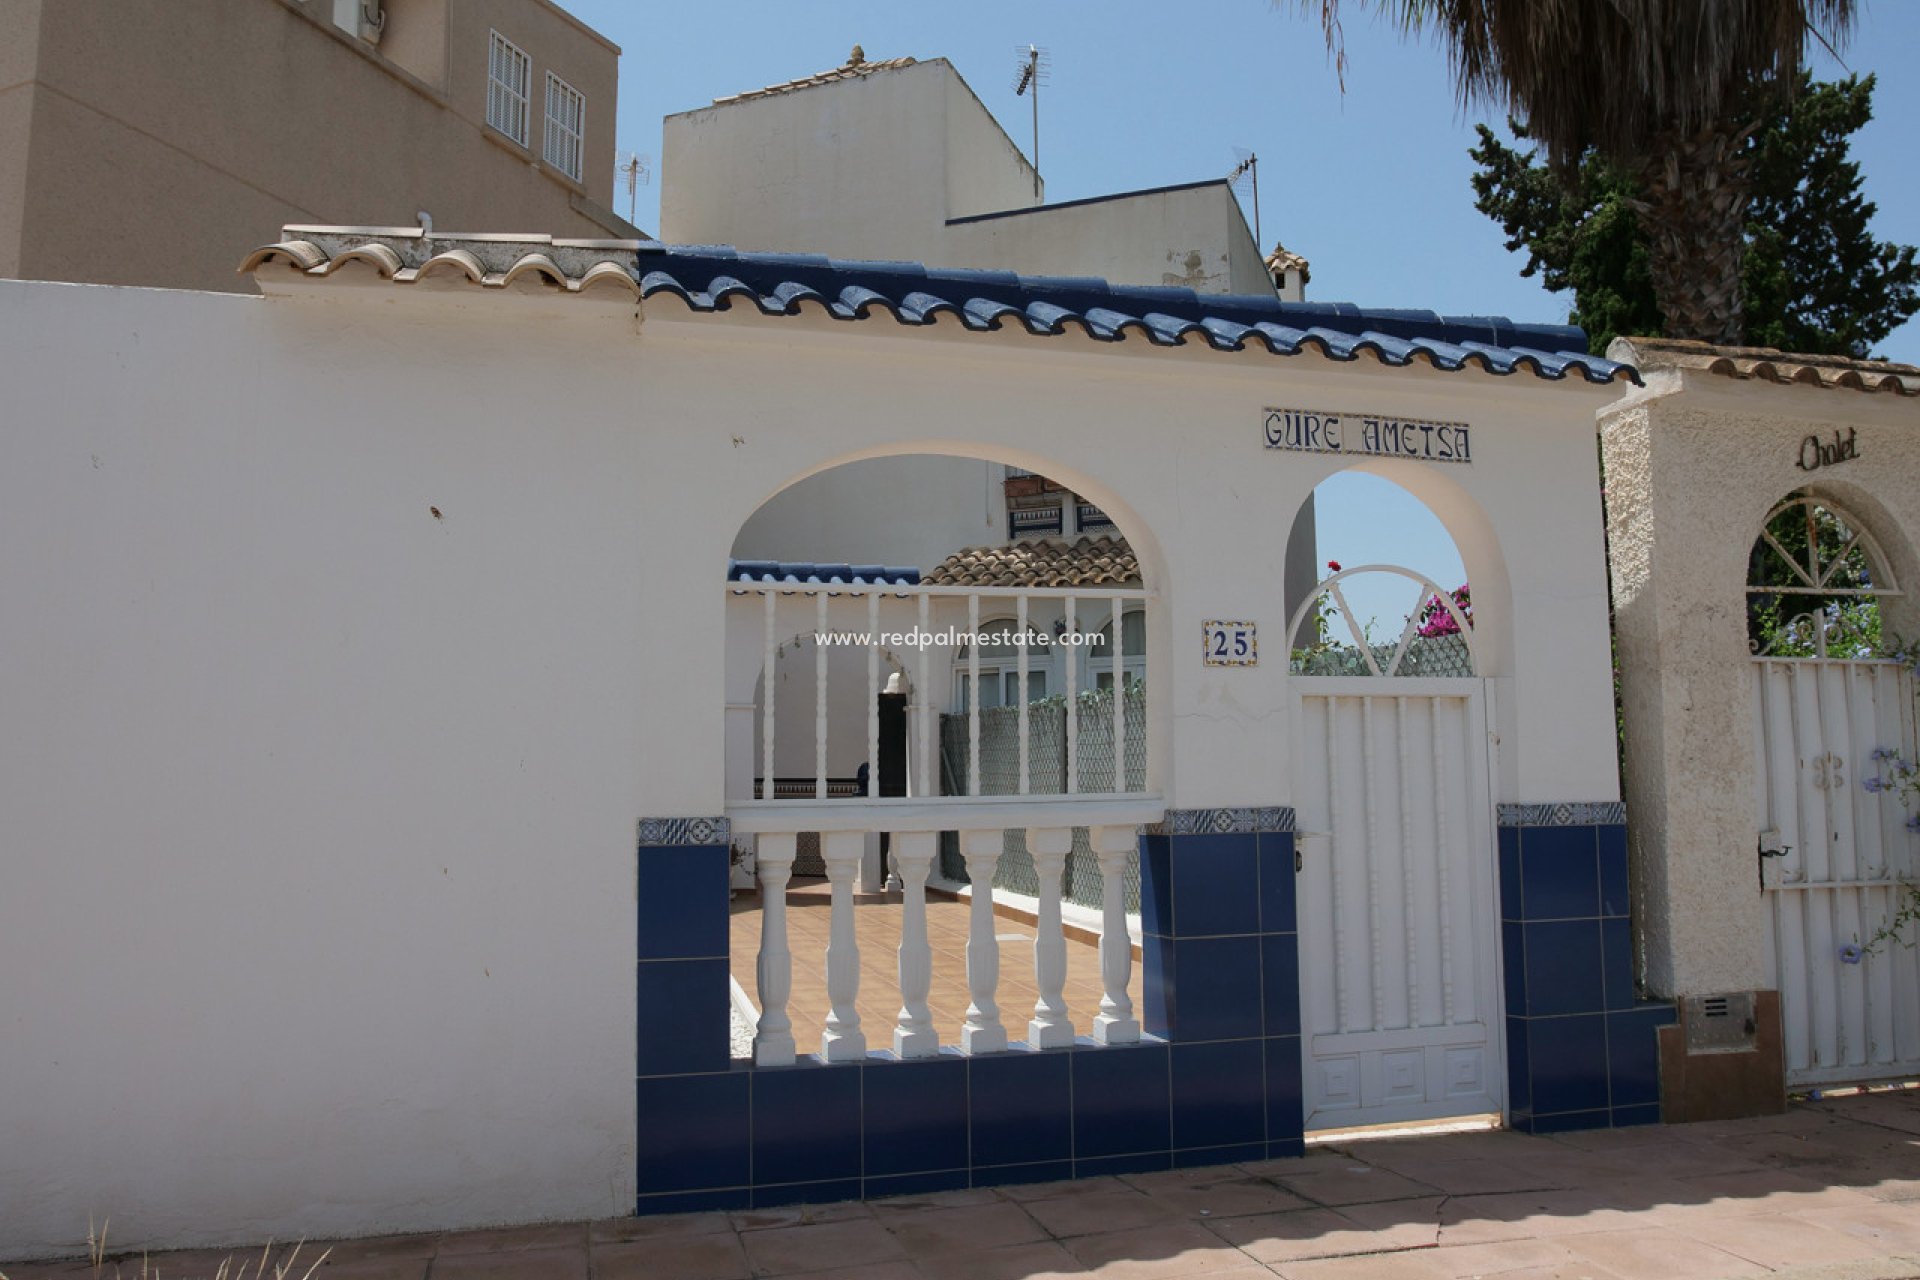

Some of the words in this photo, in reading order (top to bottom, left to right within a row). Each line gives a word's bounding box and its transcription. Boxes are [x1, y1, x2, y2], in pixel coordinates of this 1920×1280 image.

[1266, 413, 1340, 449] GURE
[1363, 420, 1470, 458] AMETSA
[1213, 631, 1249, 656] 25
